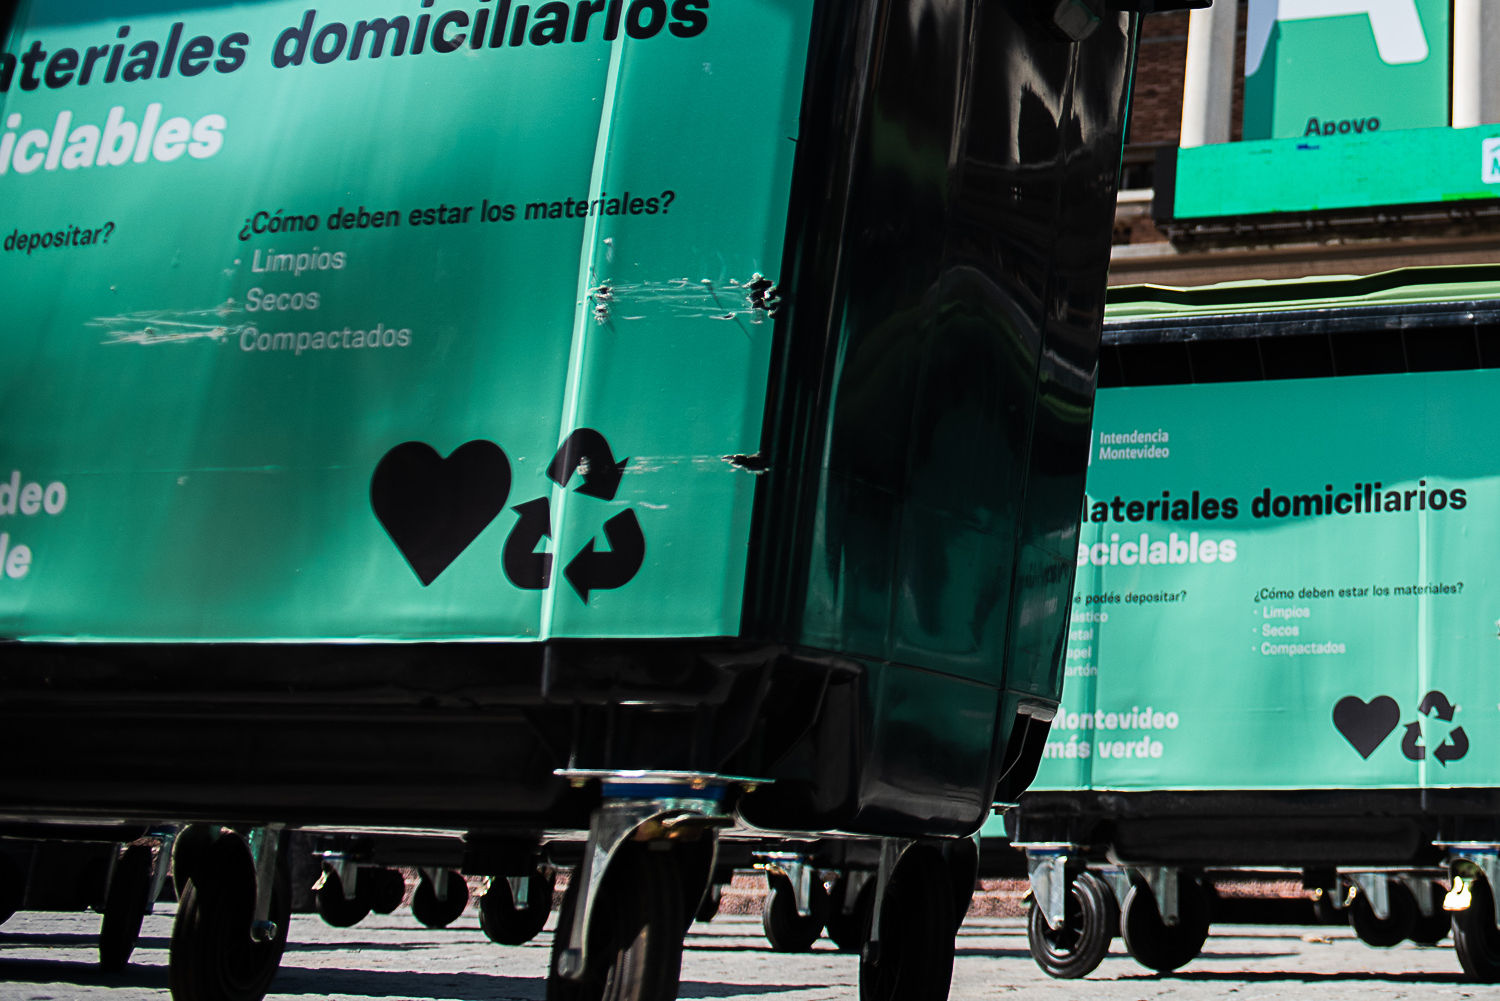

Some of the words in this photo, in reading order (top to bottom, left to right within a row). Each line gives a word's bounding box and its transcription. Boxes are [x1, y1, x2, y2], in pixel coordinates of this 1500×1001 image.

[238, 208, 319, 242] ¿Cómo
[327, 202, 400, 231] deben
[408, 203, 474, 227] estar
[480, 198, 517, 223] los
[524, 190, 676, 221] materiales?
[4, 221, 115, 255] depositar?
[251, 246, 346, 276] Limpios
[245, 287, 320, 312] Secos
[239, 323, 412, 356] Compactados
[1100, 429, 1170, 444] Intendencia
[1099, 445, 1170, 460] Montevideo
[1083, 490, 1238, 523] ateriales
[1251, 480, 1467, 518] domiciliarios
[1086, 591, 1121, 606] podés
[1124, 590, 1187, 605] depositar?
[1254, 587, 1294, 603] ¿Cómo
[1297, 586, 1334, 600] deben
[1338, 587, 1369, 599] estar
[1372, 584, 1390, 597] los
[1393, 582, 1464, 596] materiales?
[1262, 605, 1311, 620] Limpios
[1262, 623, 1299, 637] Secos
[1261, 640, 1346, 657] Compactados
[1043, 734, 1091, 759] más
[1098, 735, 1164, 759] verde
